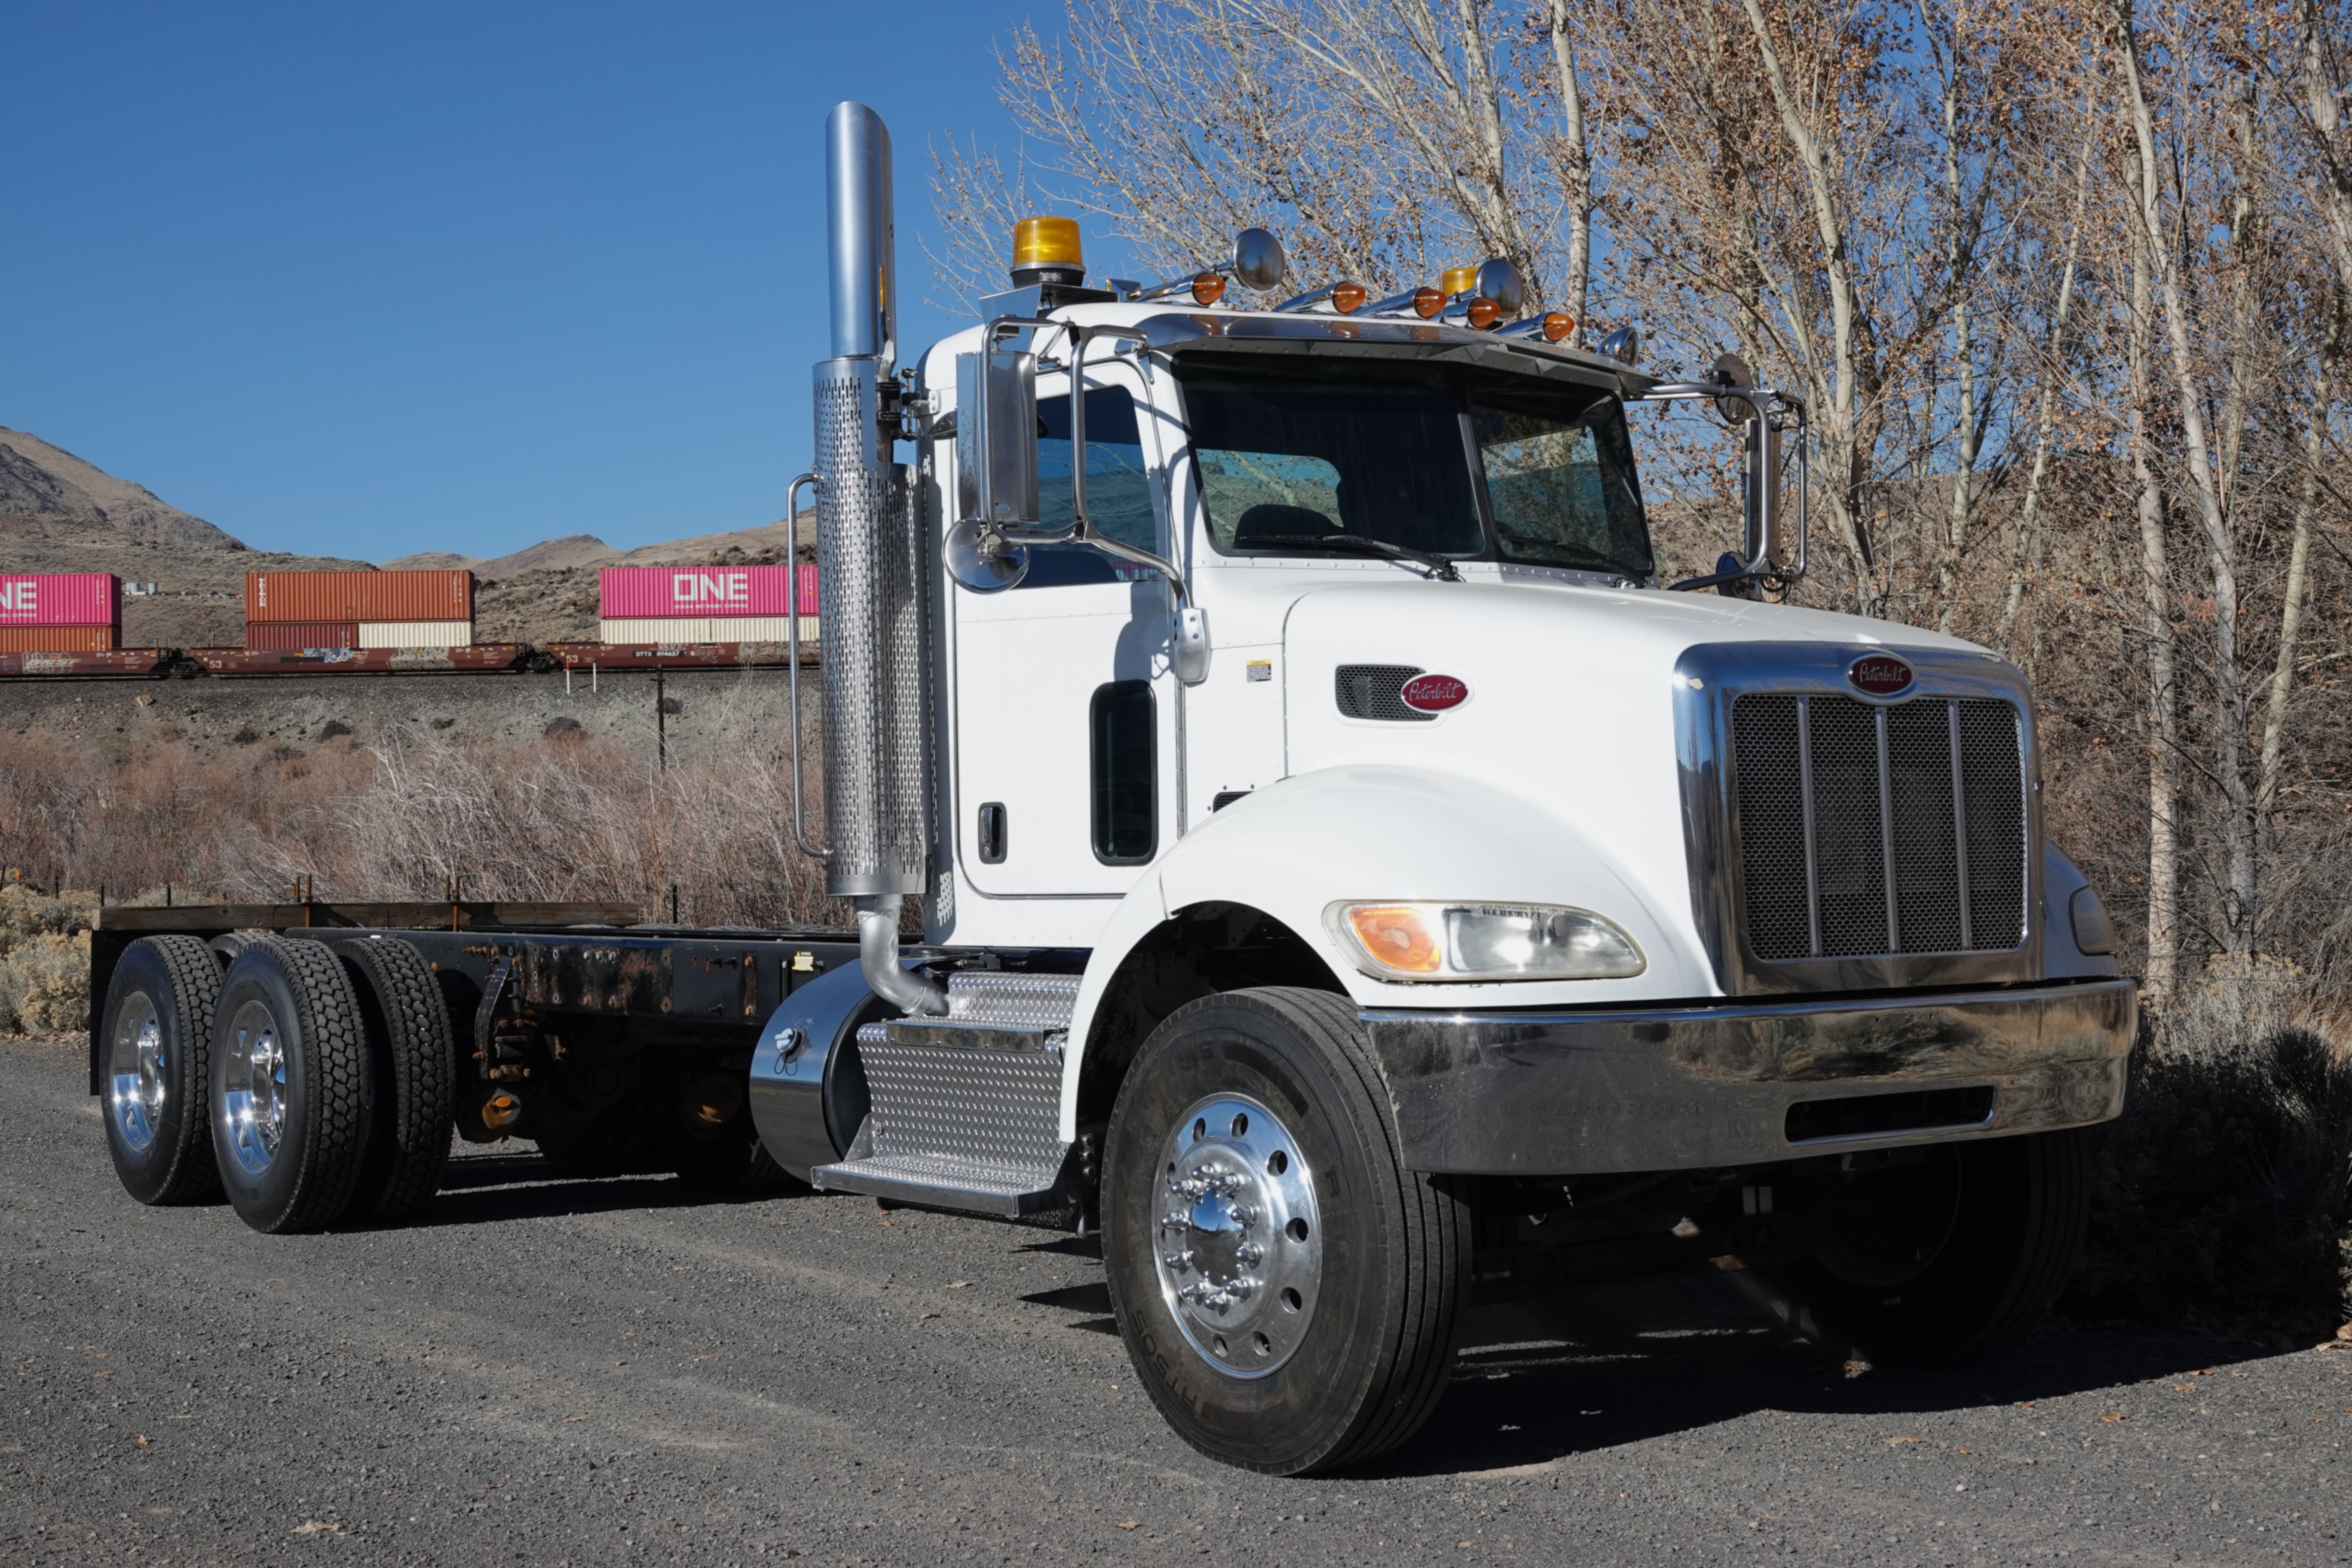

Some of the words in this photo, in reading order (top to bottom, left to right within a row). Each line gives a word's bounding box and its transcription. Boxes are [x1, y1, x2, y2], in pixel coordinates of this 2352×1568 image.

[674, 573, 748, 601] ONE
[209, 660, 222, 668] 53
[566, 655, 579, 663] 53
[1859, 663, 1907, 683] Peterbilt
[1409, 682, 1461, 701] Peterbilt
